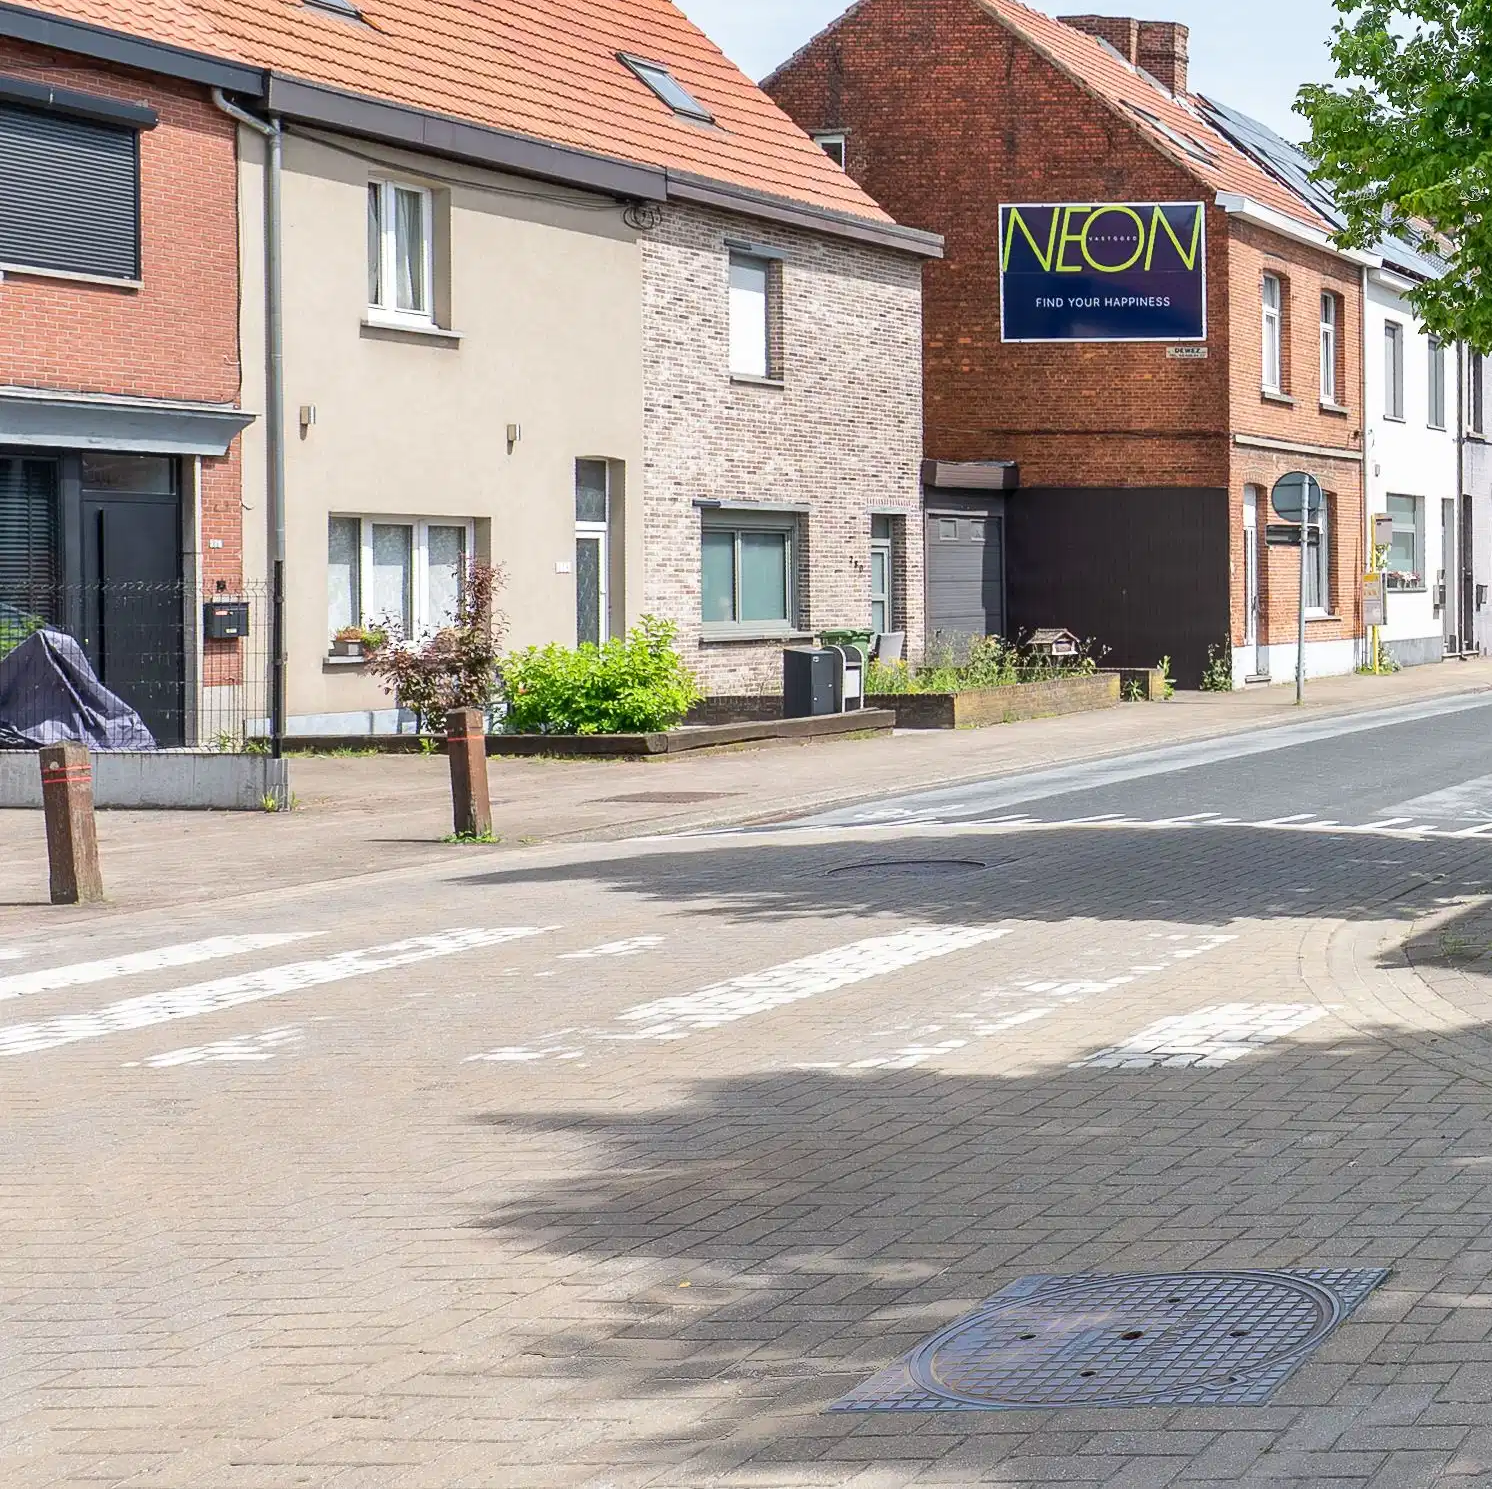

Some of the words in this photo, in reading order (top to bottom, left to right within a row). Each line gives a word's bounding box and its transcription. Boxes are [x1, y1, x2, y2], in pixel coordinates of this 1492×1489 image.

[1002, 205, 1202, 273] NEON
[1035, 297, 1064, 308] FIND
[1068, 297, 1100, 308] YOUR
[1104, 296, 1171, 307] HAPPINESS
